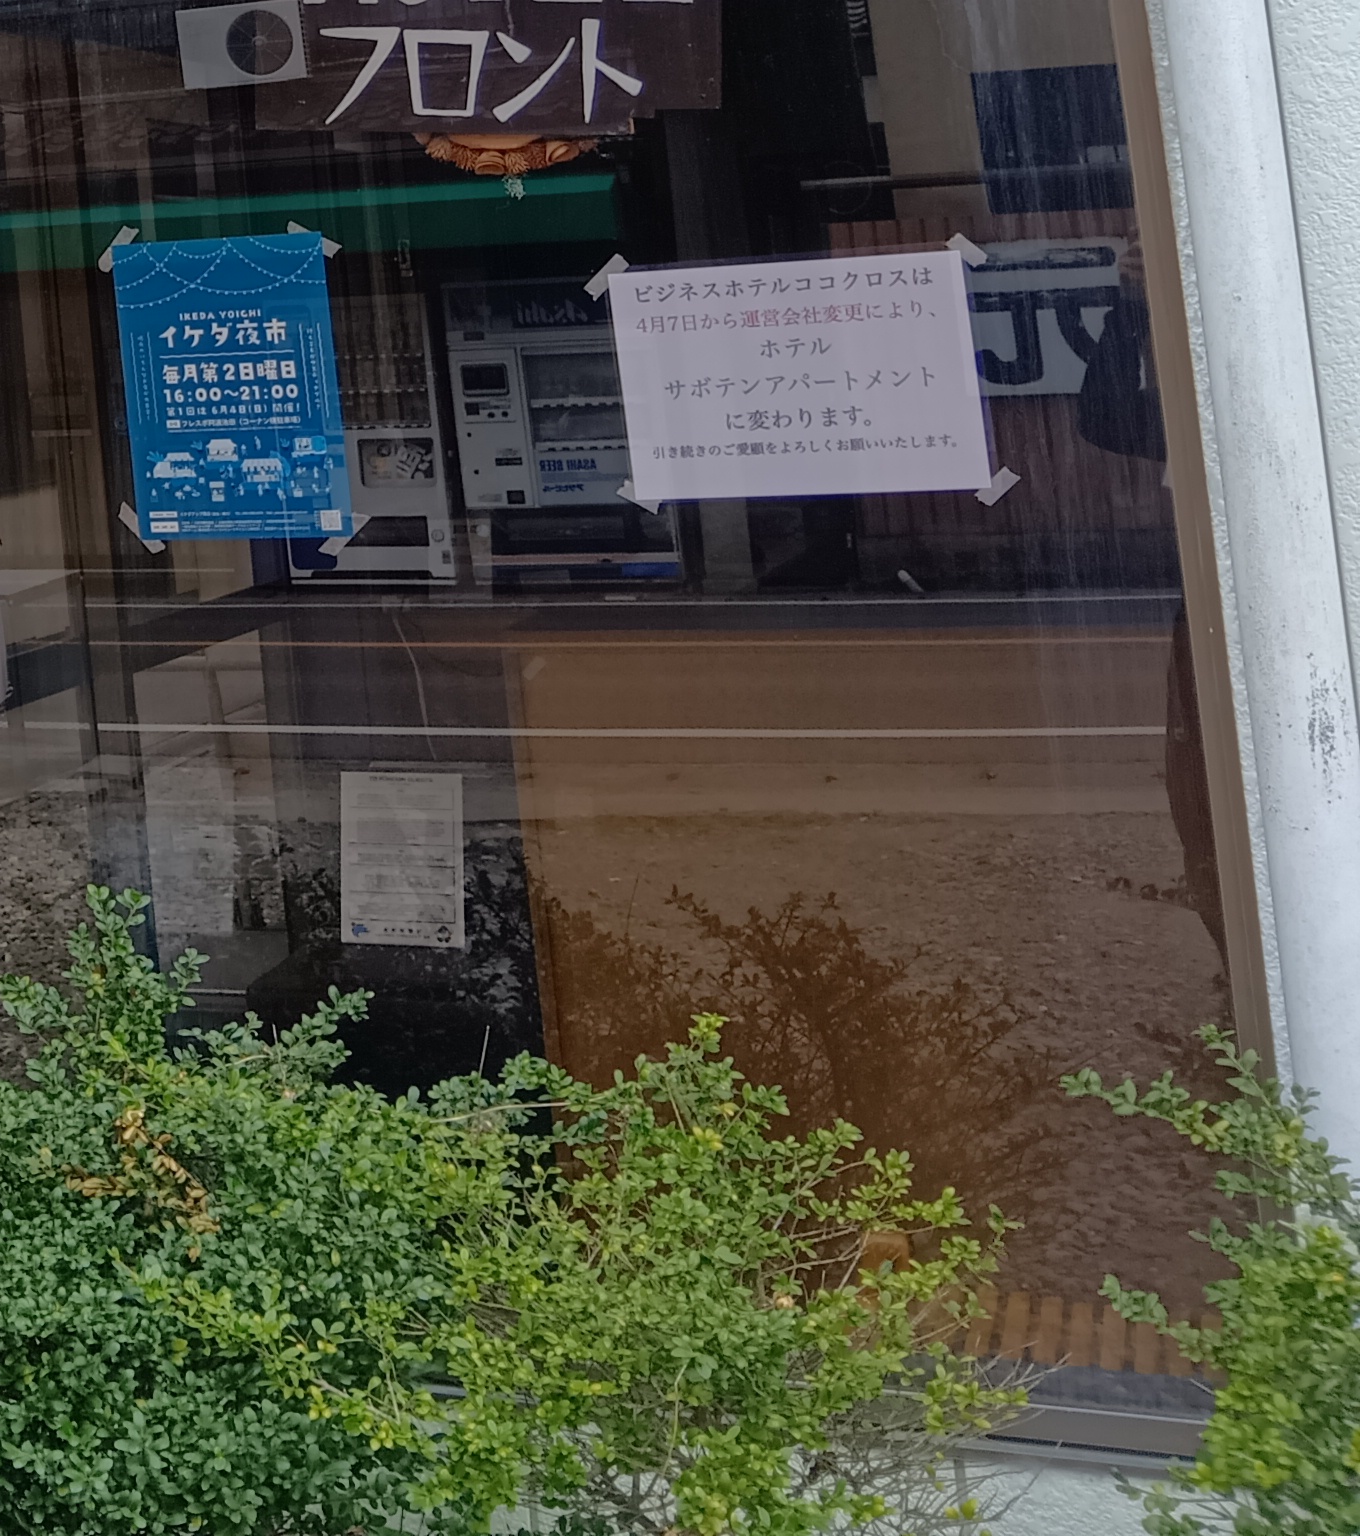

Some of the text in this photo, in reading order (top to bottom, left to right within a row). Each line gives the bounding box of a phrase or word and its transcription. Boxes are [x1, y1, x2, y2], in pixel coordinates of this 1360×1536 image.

[319, 17, 645, 125] フロント
[633, 266, 934, 304] ビジネスホテルココクロスは
[178, 308, 262, 321] IKEDA YOICHI
[635, 300, 938, 335] 4月7日から運営会社変更により、
[158, 317, 288, 349] イケダ夜市
[759, 336, 833, 359] ホテル
[161, 359, 297, 385] 毎月第2日曜日
[664, 365, 937, 401] サボテンアパートメント
[725, 404, 875, 432] に変わります。
[652, 433, 958, 460] 引き続きのご愛顧をよろしくお願いいたします。
